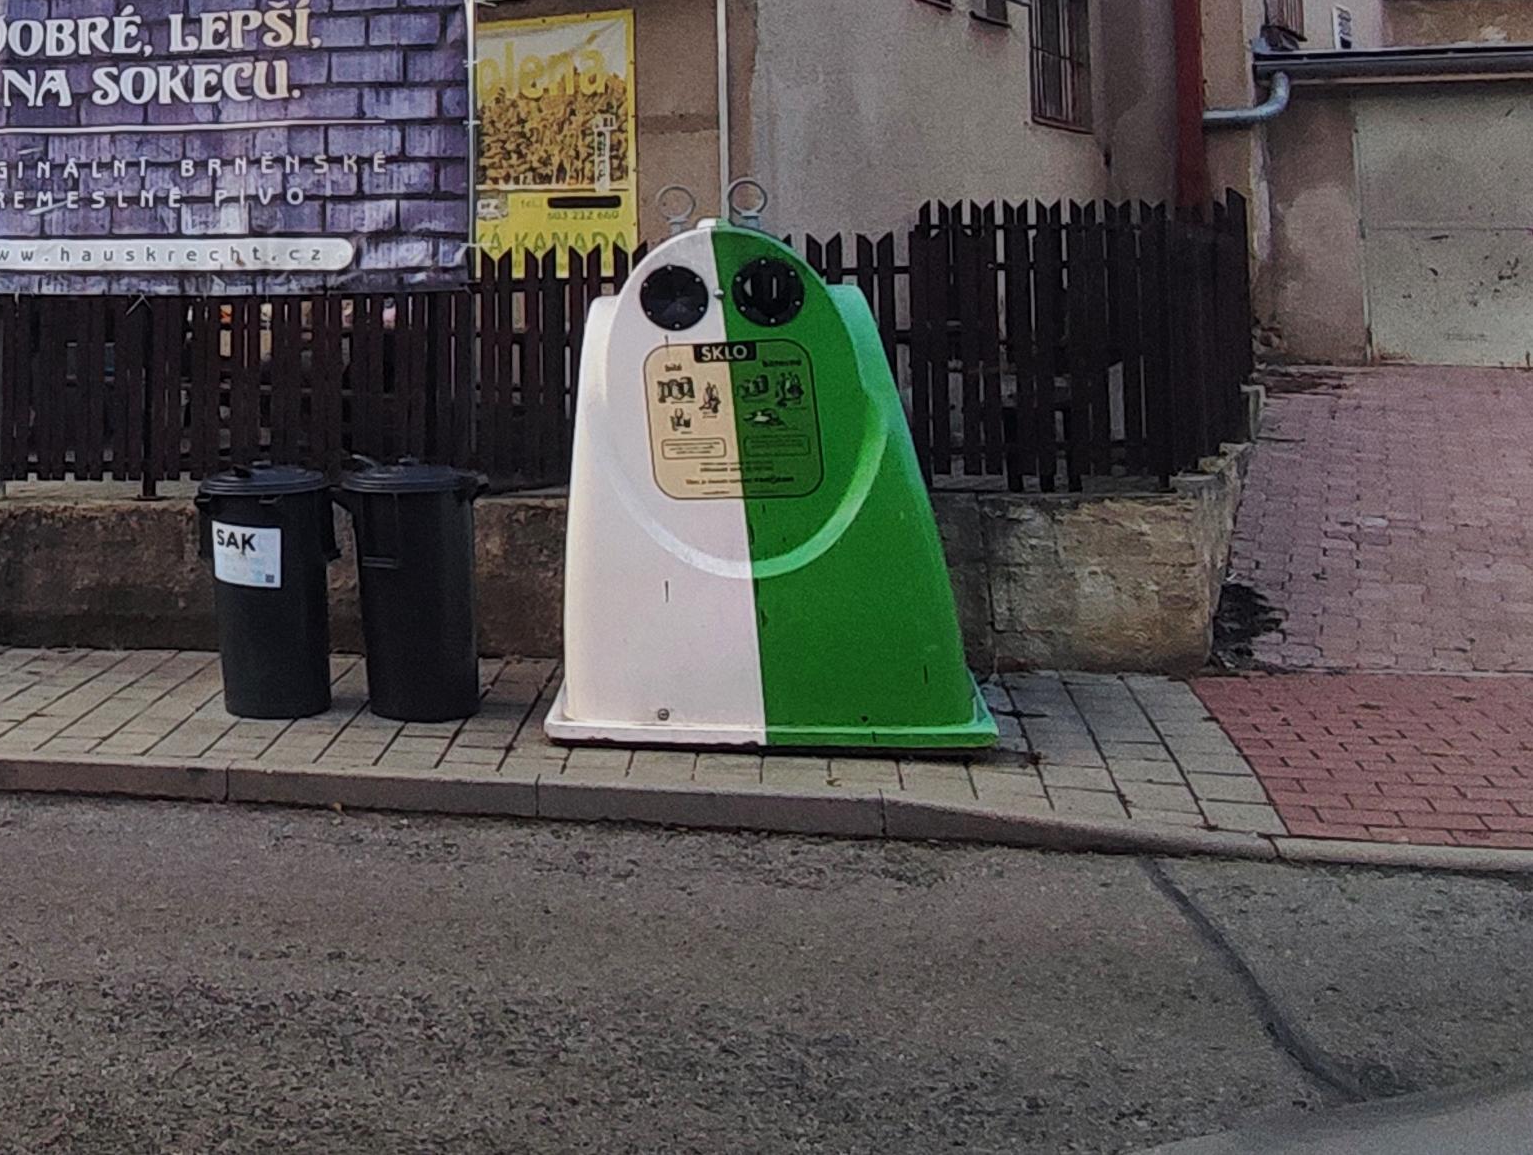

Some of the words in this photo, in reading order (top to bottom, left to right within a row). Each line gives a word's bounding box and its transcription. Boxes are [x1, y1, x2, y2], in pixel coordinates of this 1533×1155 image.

[2, 68, 73, 108] NA
[92, 59, 302, 106] SOKECU.
[180, 151, 388, 179] BRNĚNSKÉ
[214, 187, 305, 207] PIVO
[514, 231, 628, 255] KANADA
[700, 345, 748, 361] SKLO
[215, 528, 256, 555] SAK
